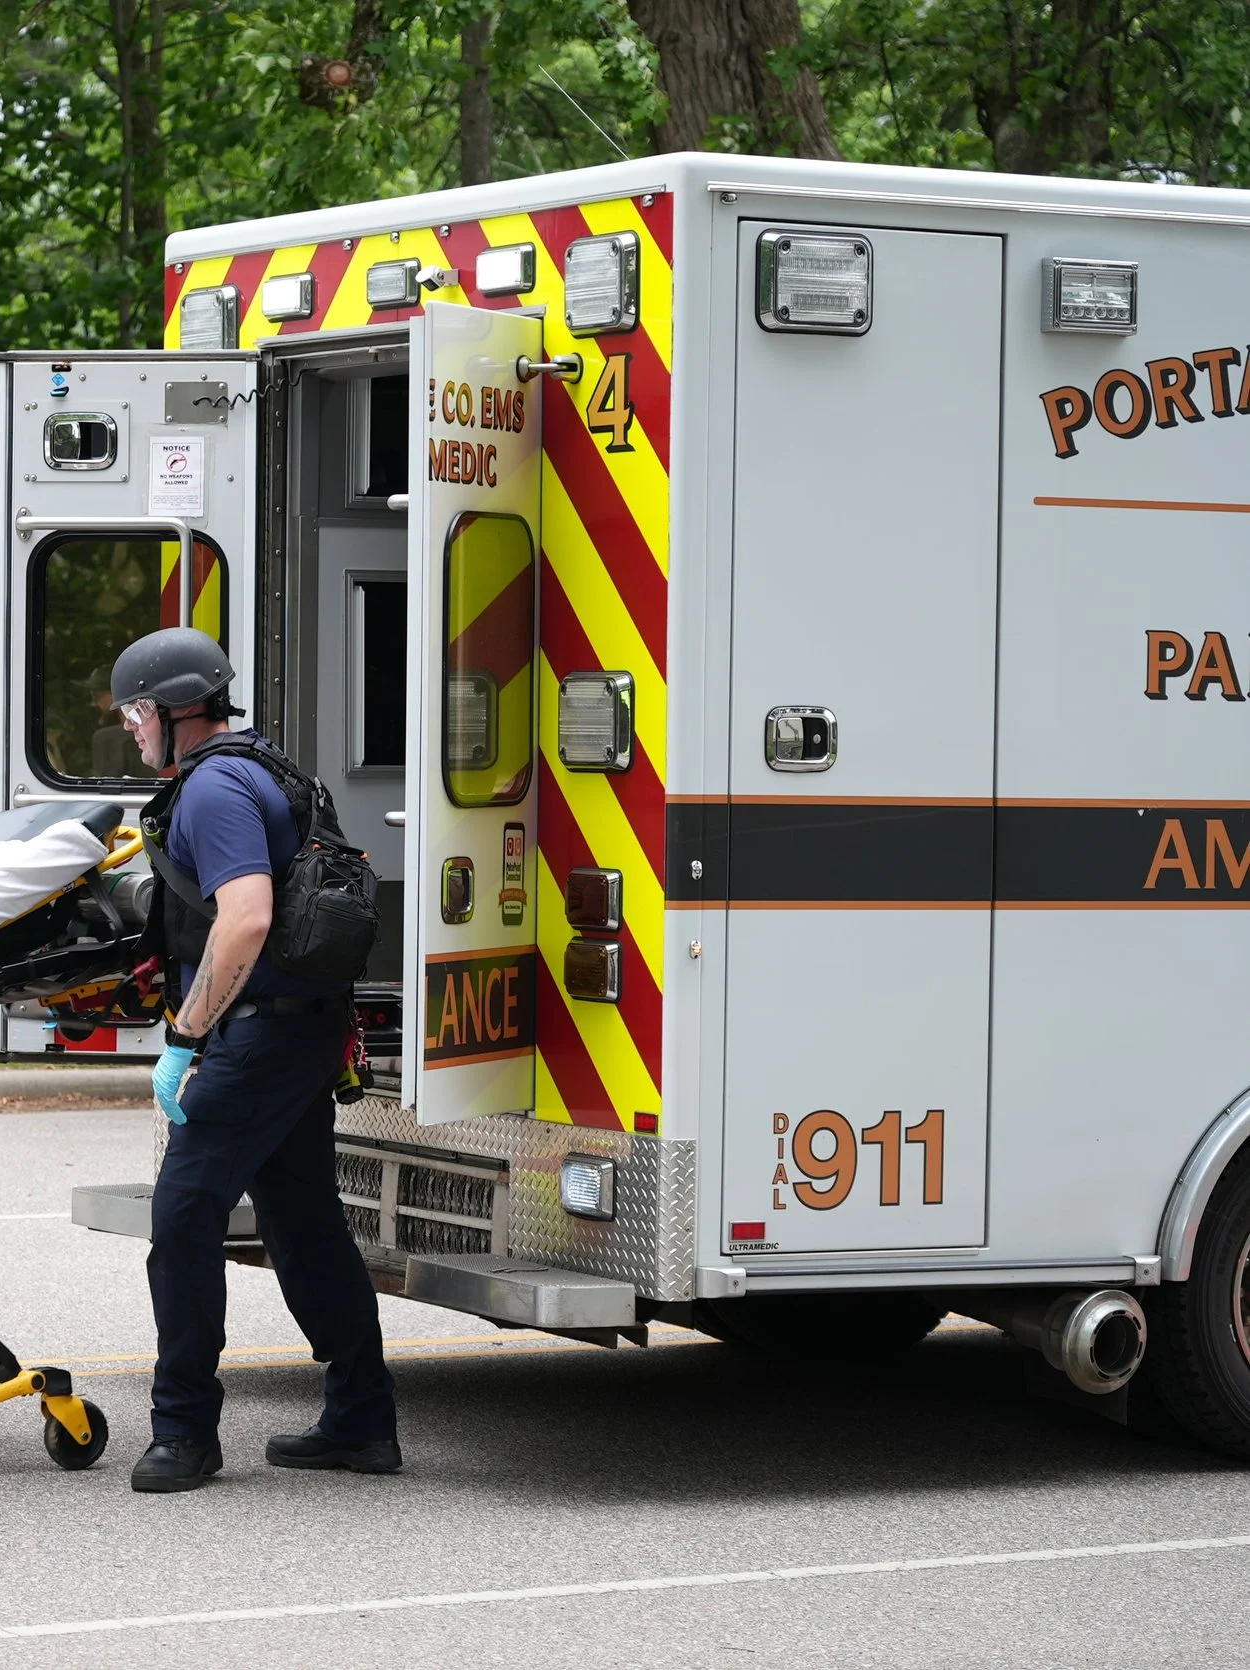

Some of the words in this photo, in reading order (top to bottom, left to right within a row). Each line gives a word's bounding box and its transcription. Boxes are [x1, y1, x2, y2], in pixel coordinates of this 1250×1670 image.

[442, 380, 476, 428] CO.
[481, 386, 525, 434] EMS
[586, 353, 636, 453] 4
[1039, 345, 1250, 459] PORT
[428, 438, 497, 488] MEDIC
[1144, 630, 1250, 701] PA
[424, 967, 519, 1049] LANCE
[772, 1112, 789, 1210] DIAL
[792, 1109, 945, 1211] 911
[729, 1242, 780, 1252] ULTRAMEDIC
